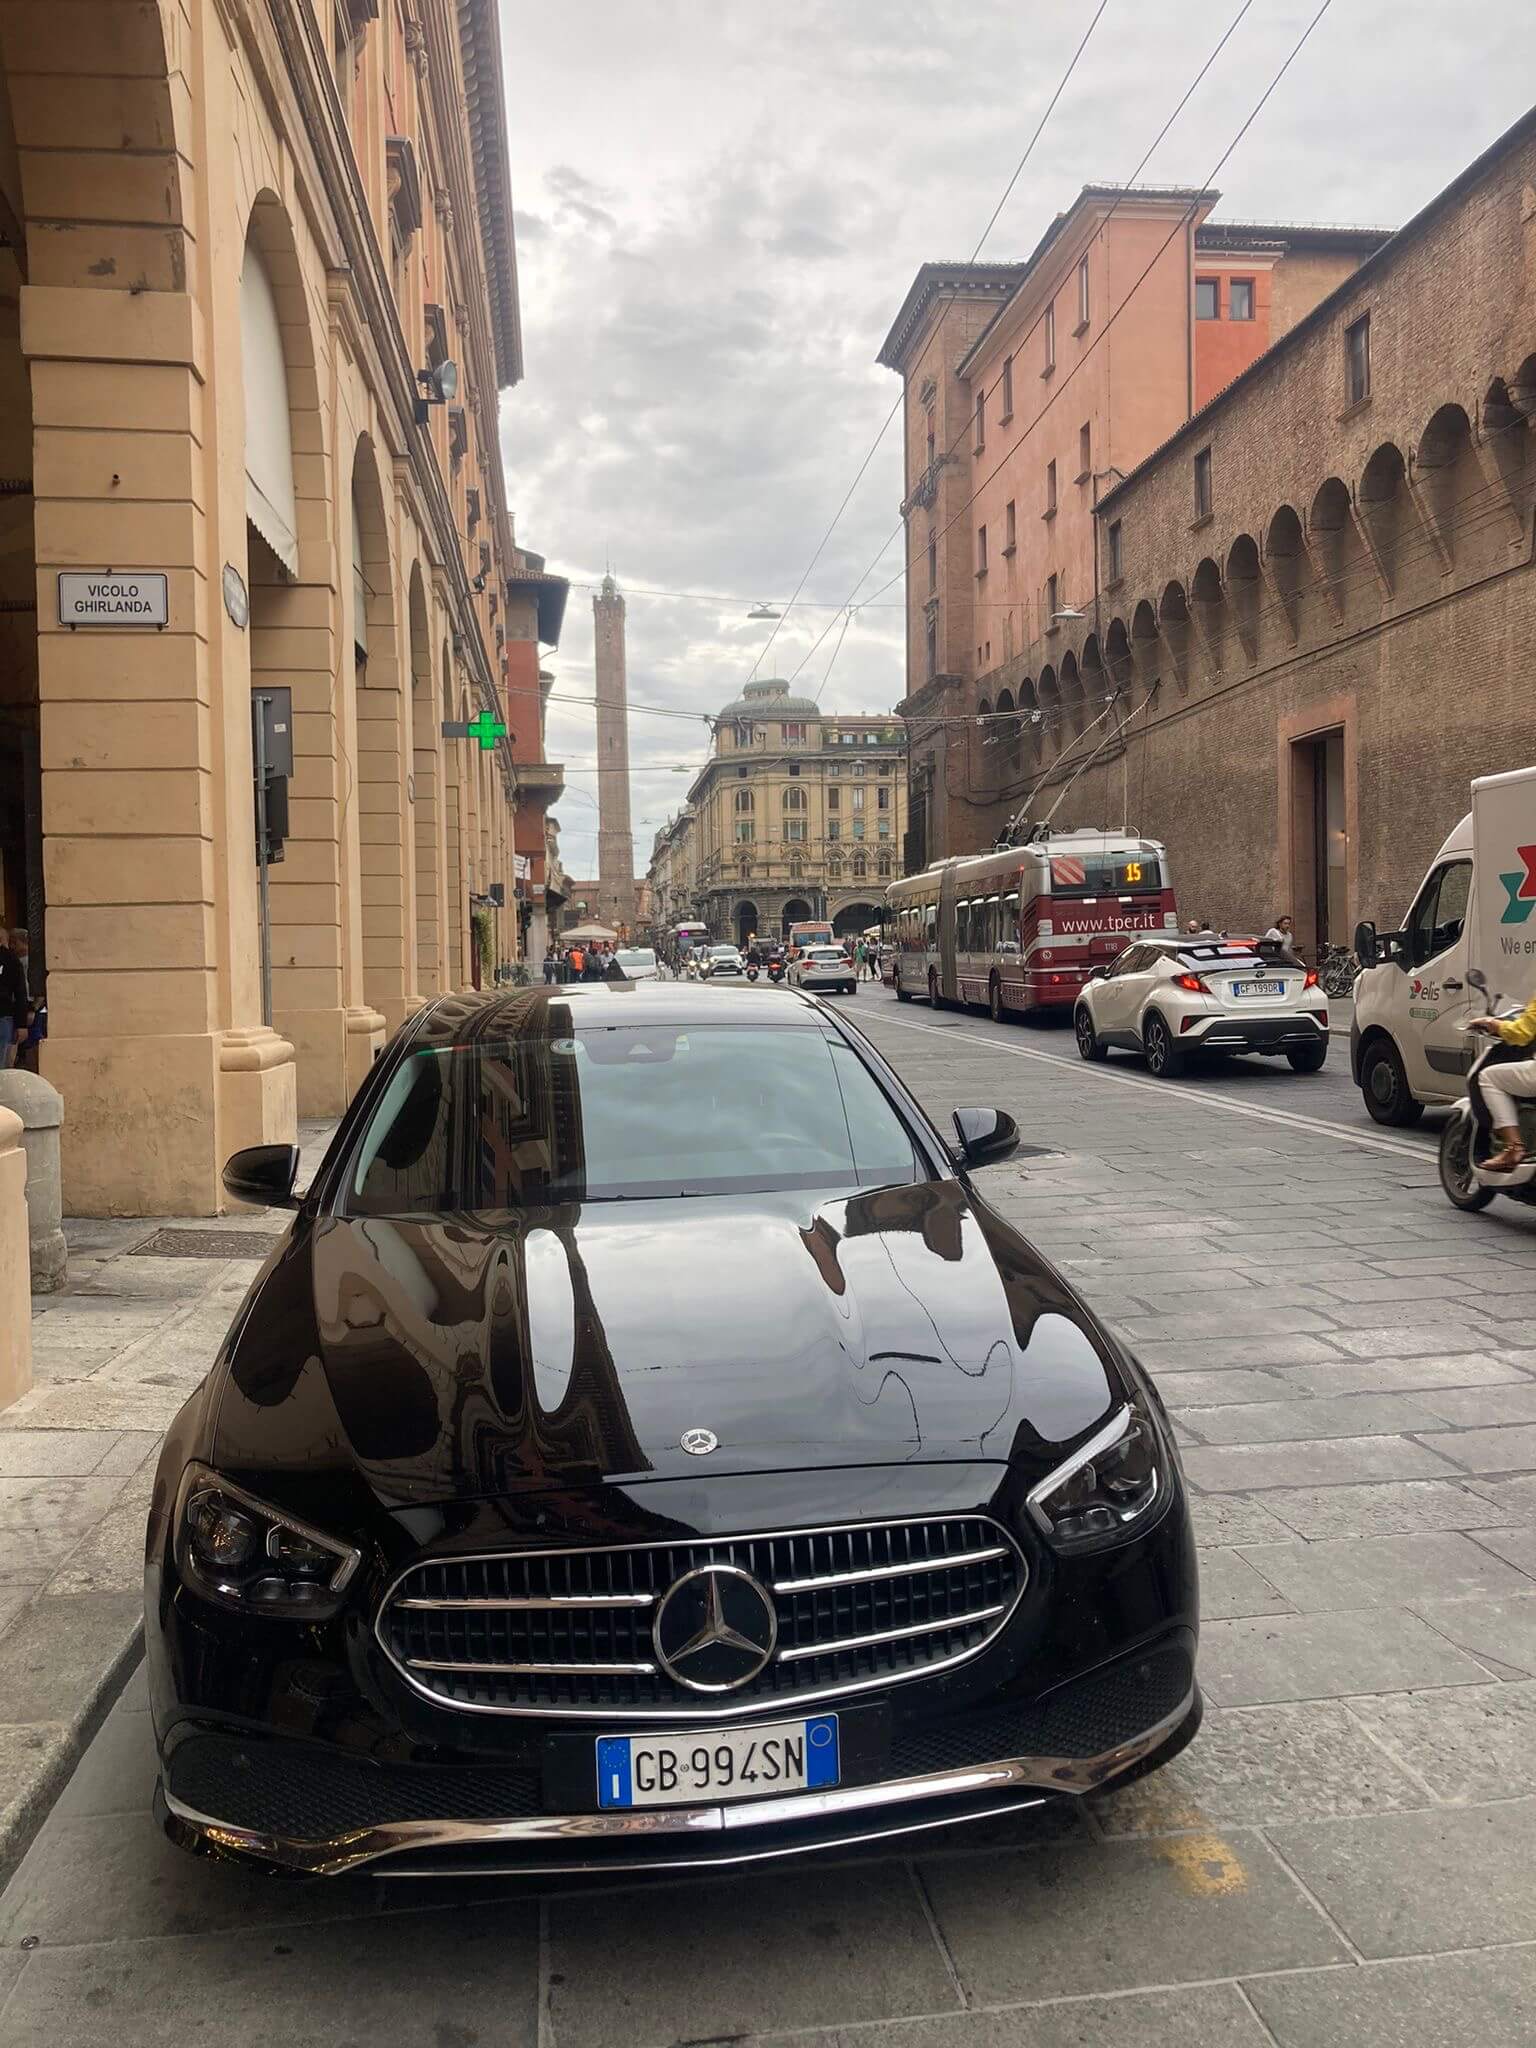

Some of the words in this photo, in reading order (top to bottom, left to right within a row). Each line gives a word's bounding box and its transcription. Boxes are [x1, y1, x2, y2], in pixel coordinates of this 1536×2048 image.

[88, 585, 139, 597] VICOLO
[74, 600, 152, 613] GHIRLANDA
[1126, 863, 1141, 881] 15
[1062, 913, 1156, 933] www.tper.it
[1500, 936, 1521, 955] We
[1420, 981, 1440, 1000] elis
[635, 1750, 678, 1792] GB
[691, 1736, 804, 1788] 994SN
